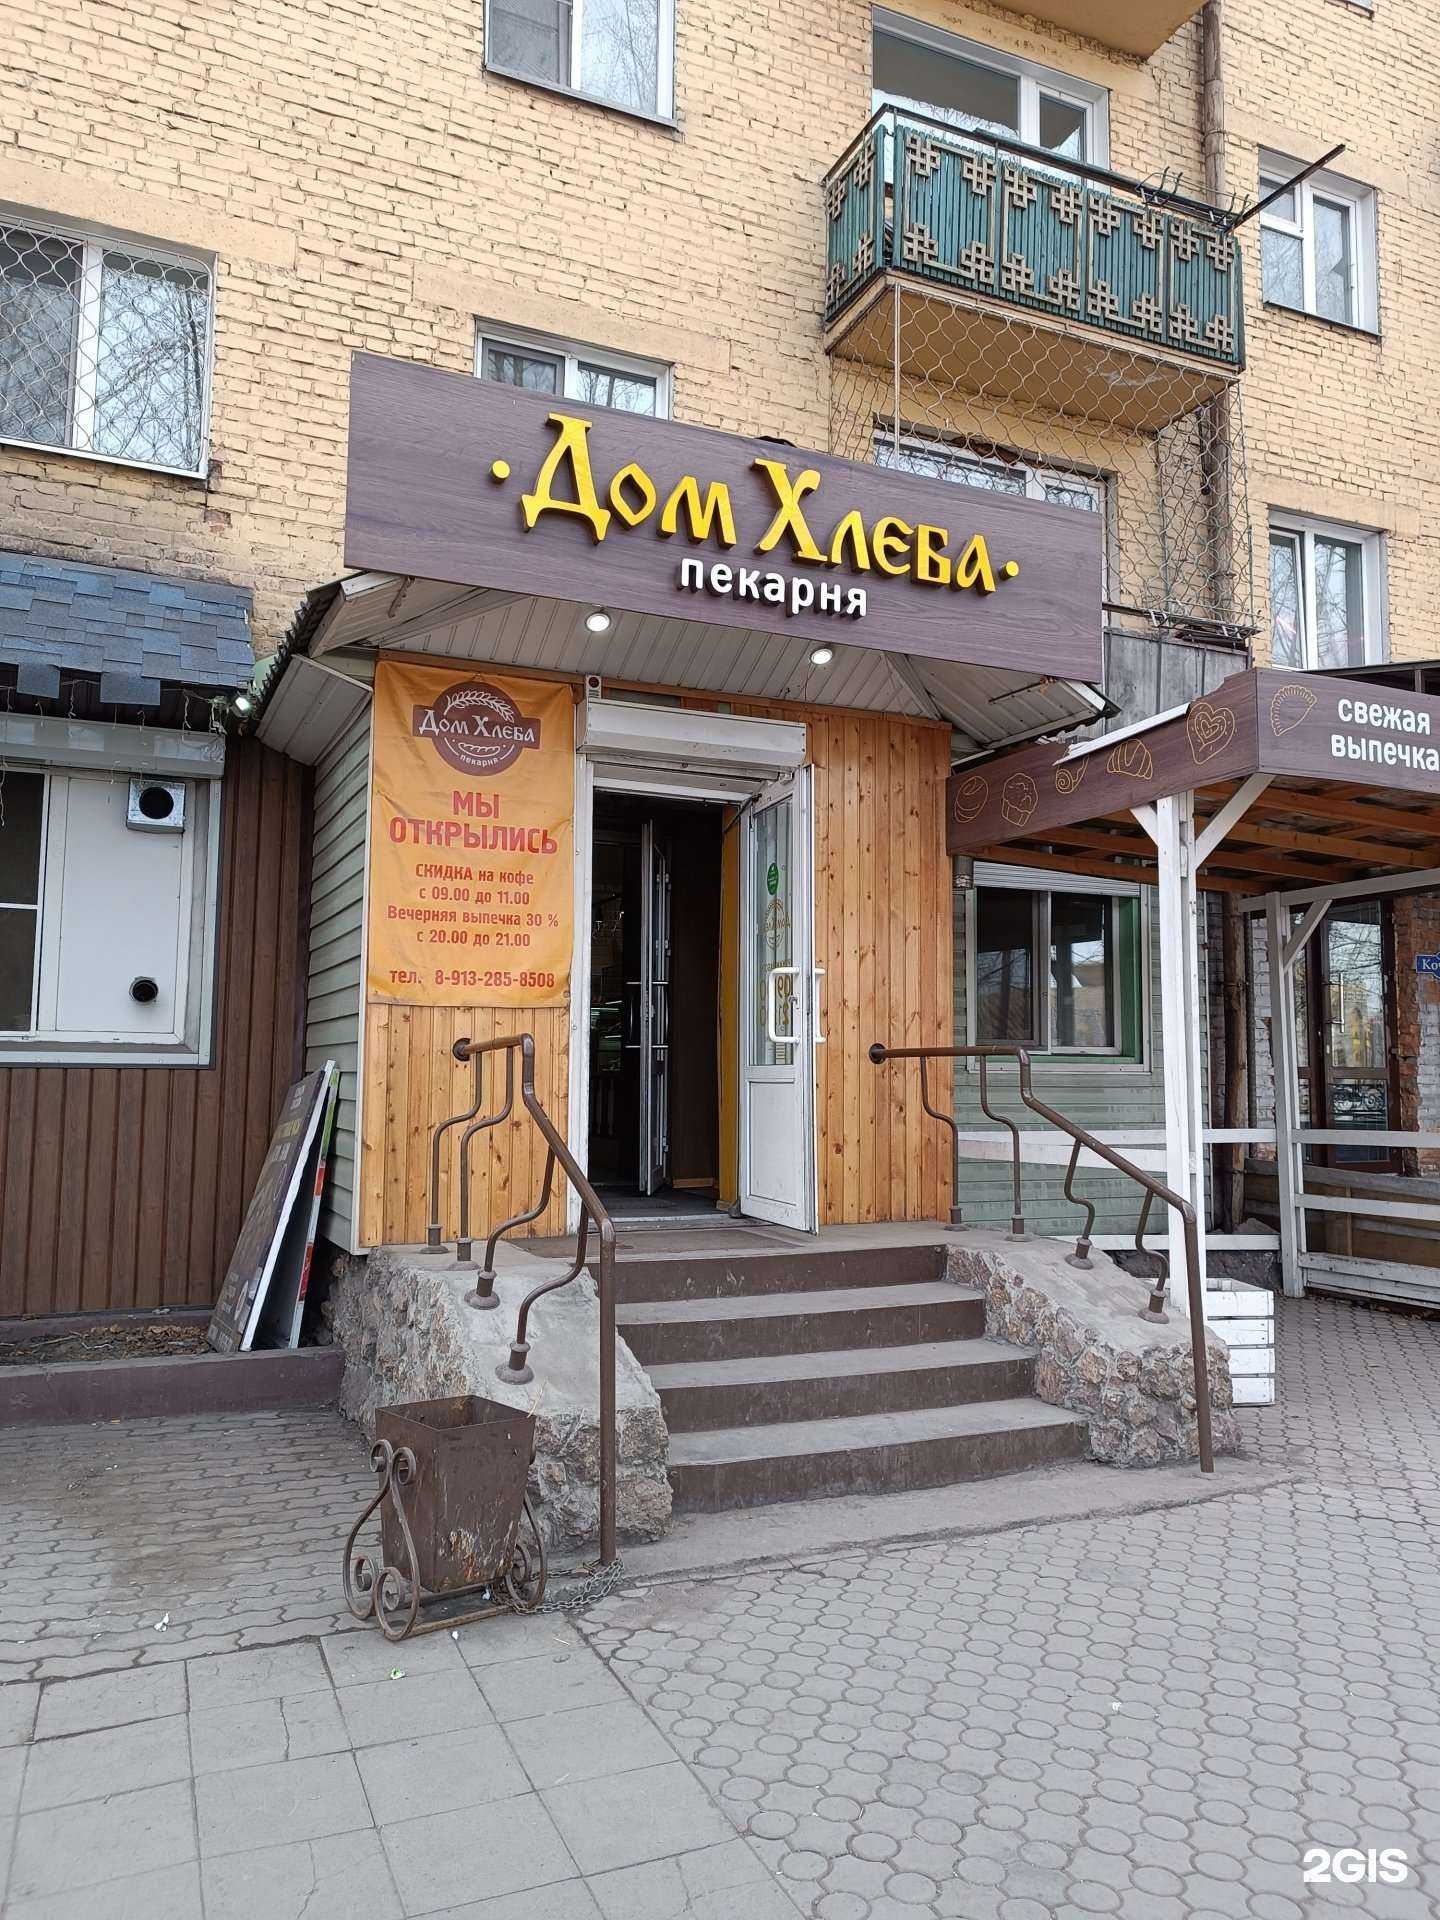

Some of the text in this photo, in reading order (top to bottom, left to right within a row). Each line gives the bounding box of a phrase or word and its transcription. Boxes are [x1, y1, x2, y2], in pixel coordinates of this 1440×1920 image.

[680, 557, 868, 617] пекарня
[1338, 698, 1431, 735] свежая
[459, 753, 499, 768] пекарня
[1331, 734, 1440, 771] выпечка
[452, 790, 500, 819] МЫ
[389, 816, 558, 855] ОТКРЫЛИСЬ
[415, 863, 534, 886] СКИДКА на кофе
[419, 886, 530, 905] с 09.00 до 11.00
[387, 905, 559, 927] Вечерняя выпечка 30 %
[416, 929, 531, 947] с 20.00 до 21.00
[389, 969, 555, 988] тел. 8-913-285-8508
